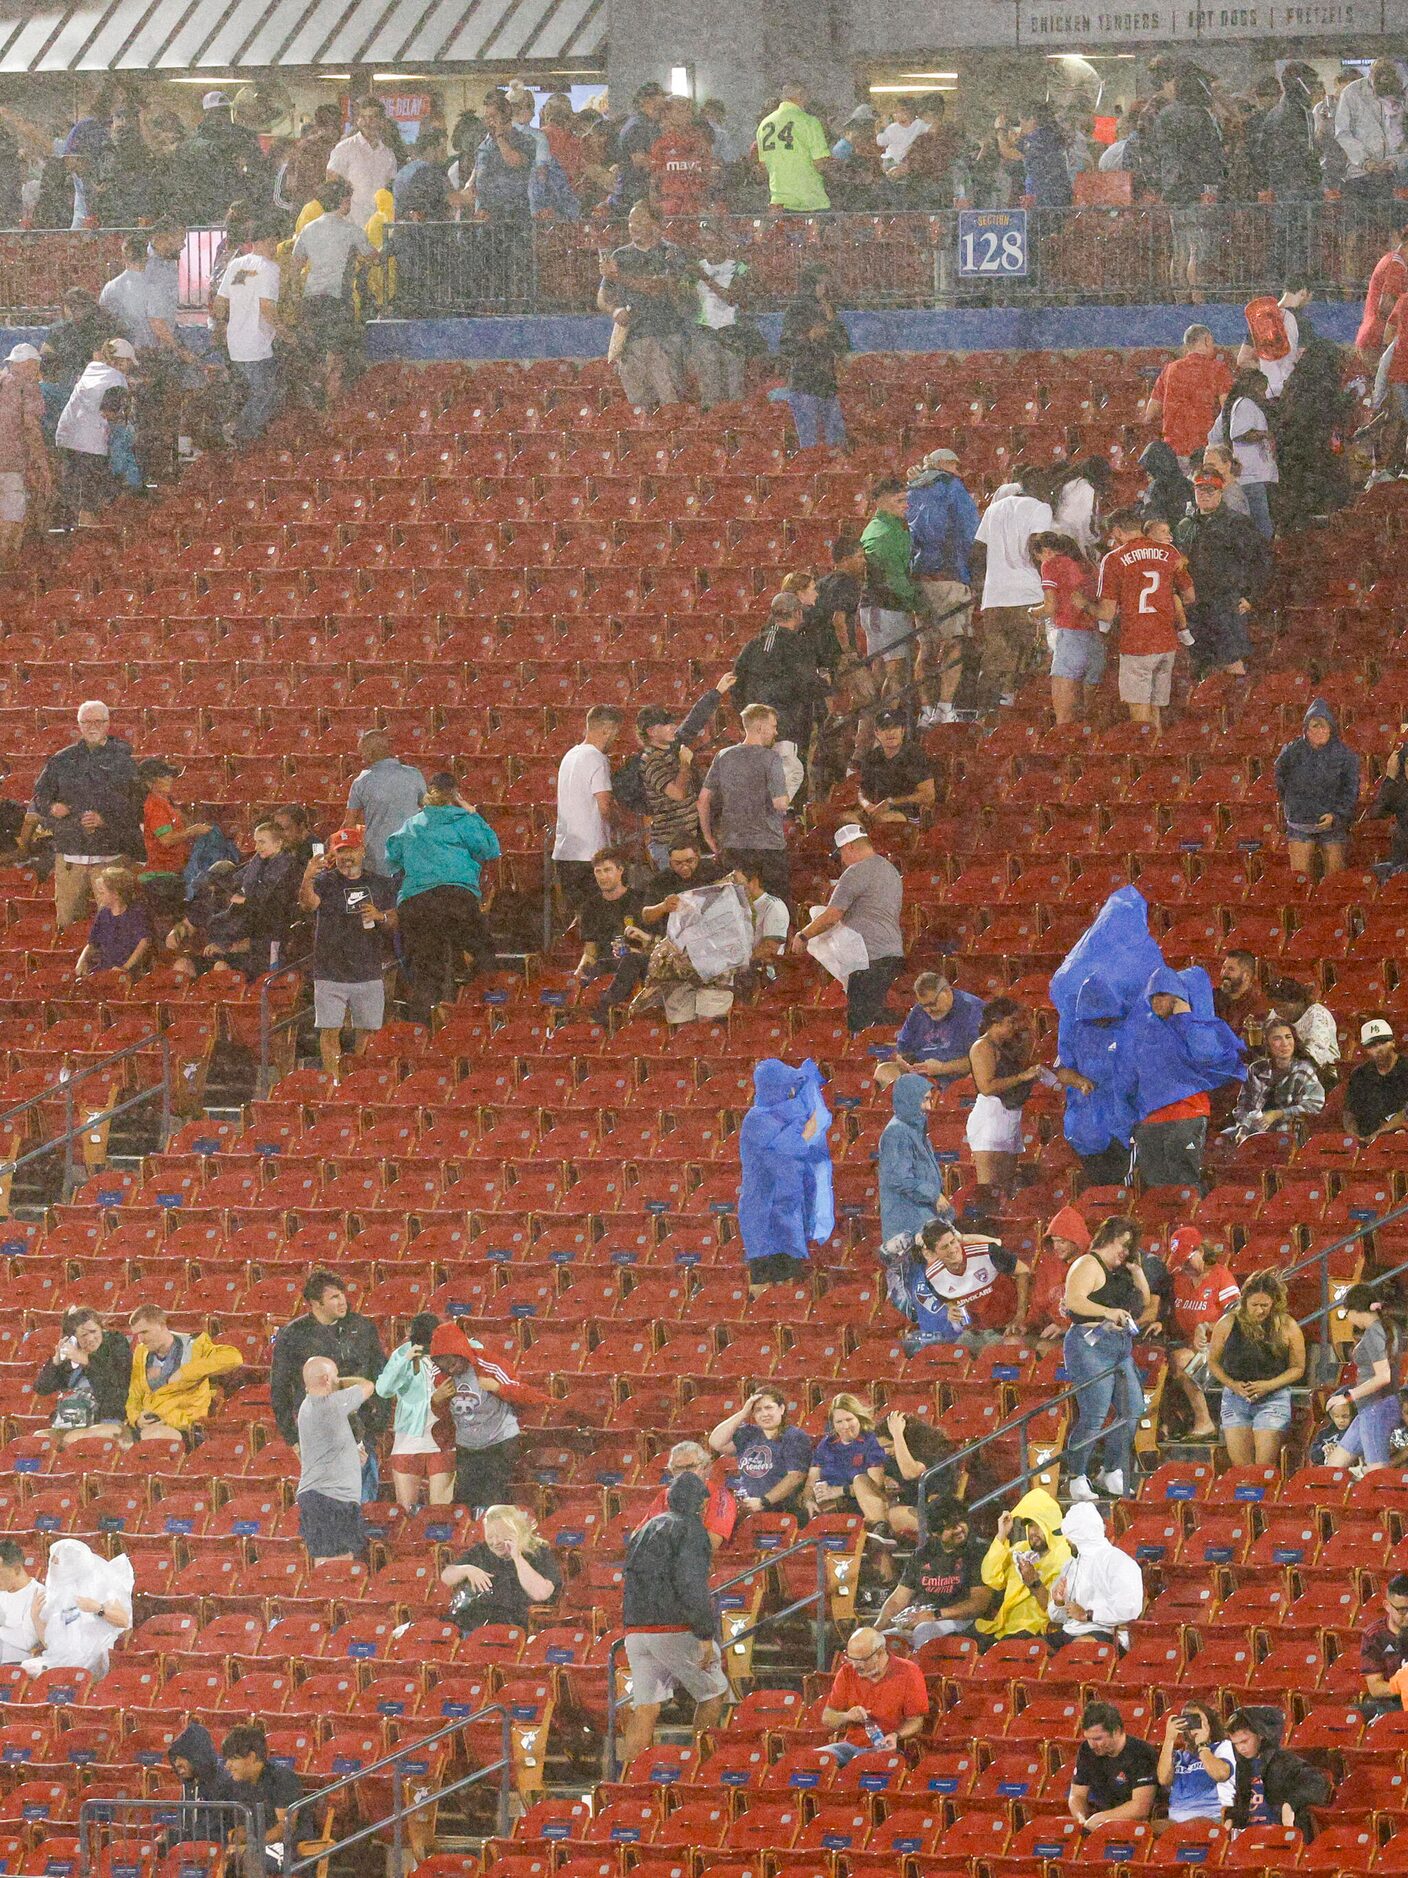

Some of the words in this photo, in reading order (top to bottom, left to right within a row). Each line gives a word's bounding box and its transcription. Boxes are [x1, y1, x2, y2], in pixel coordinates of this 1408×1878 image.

[762, 121, 794, 151] 24
[977, 214, 1009, 227] SECTION
[962, 231, 1024, 271] 128
[1120, 548, 1169, 567] HERNANDEZ
[1138, 570, 1160, 614] 2
[956, 1286, 993, 1305] ADVOCARE
[1183, 1299, 1208, 1311] DALLAS
[921, 1575, 961, 1587] Emirates
